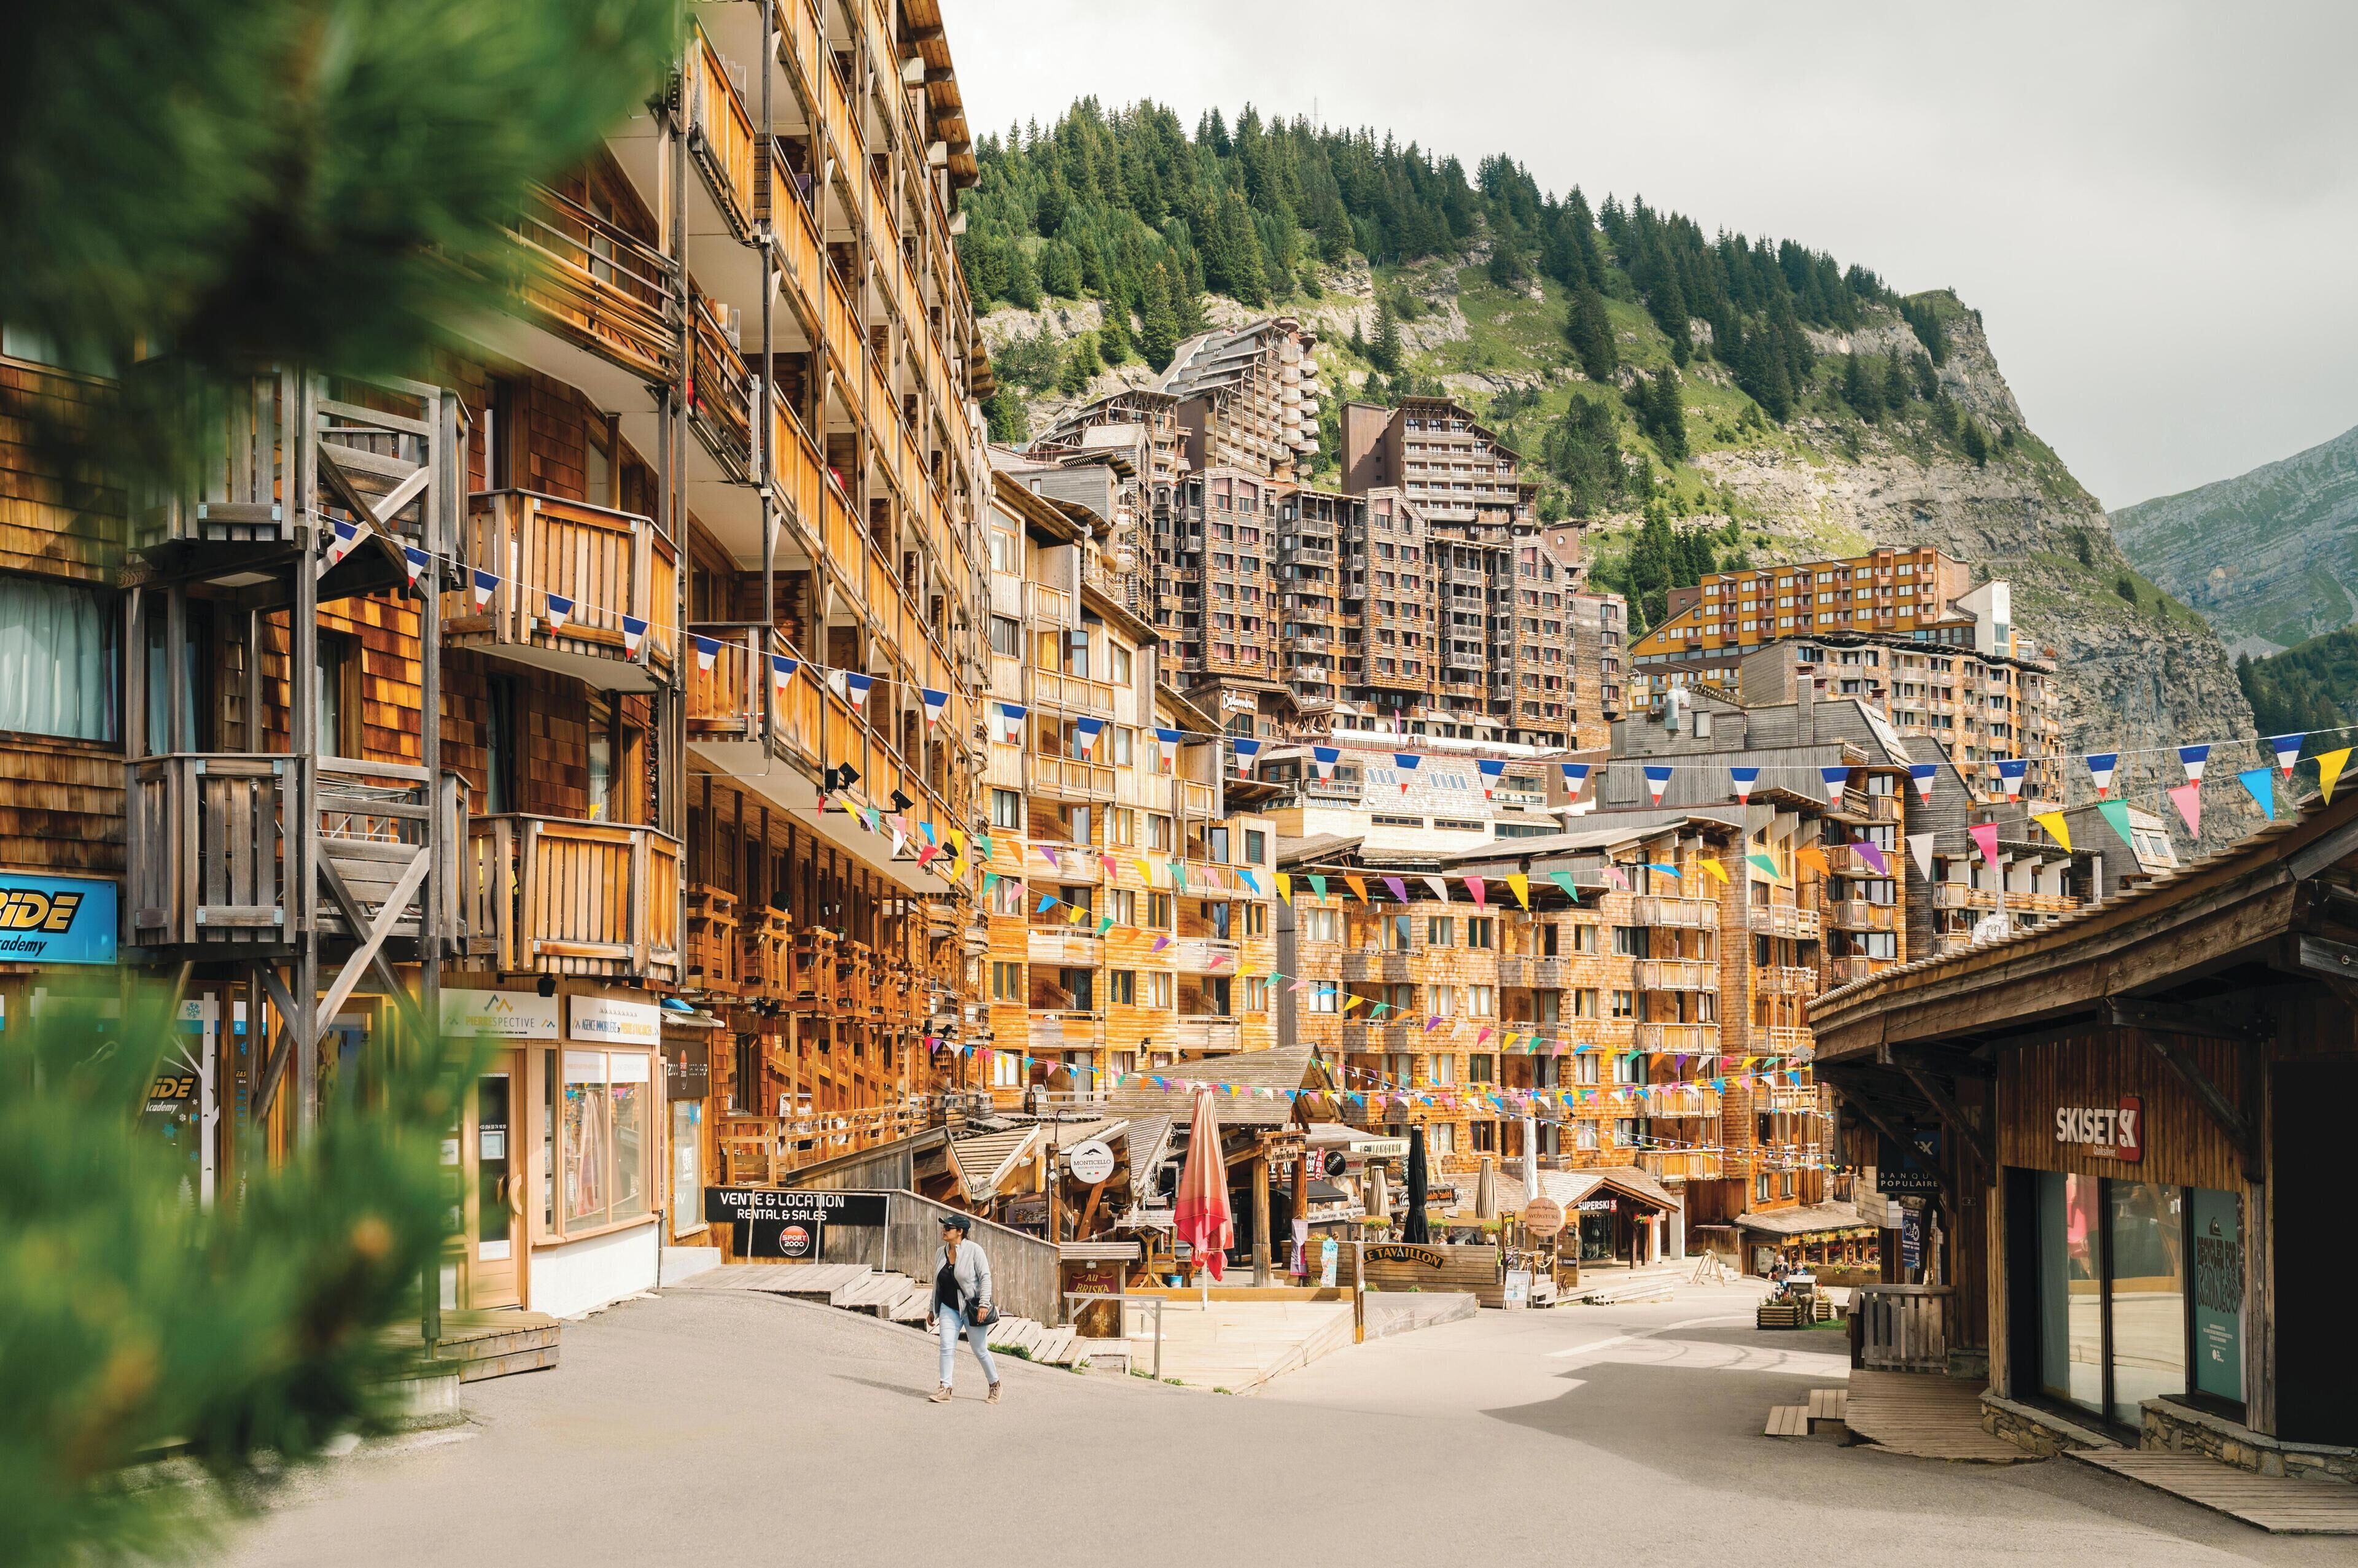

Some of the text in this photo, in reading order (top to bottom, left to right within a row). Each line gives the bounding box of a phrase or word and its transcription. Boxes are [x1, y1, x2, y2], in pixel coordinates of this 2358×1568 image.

[1221, 690, 1256, 710] Belambra
[2056, 1107, 2118, 1145] SKISET
[2093, 1144, 2116, 1157] Quiksilver
[1315, 1149, 1324, 1179] TABAC
[720, 1192, 844, 1208] VENTE & LOCATION
[1578, 1200, 1609, 1211] SUPERSKI
[737, 1209, 827, 1221] RENTAL & SALES
[1376, 1246, 1440, 1267] TAVAILLON
[2197, 1236, 2236, 1270] RECYCLED FOR
[1085, 1273, 1099, 1282] AU
[1074, 1283, 1110, 1294] BRISKA
[2197, 1263, 2238, 1314] RADNESS
